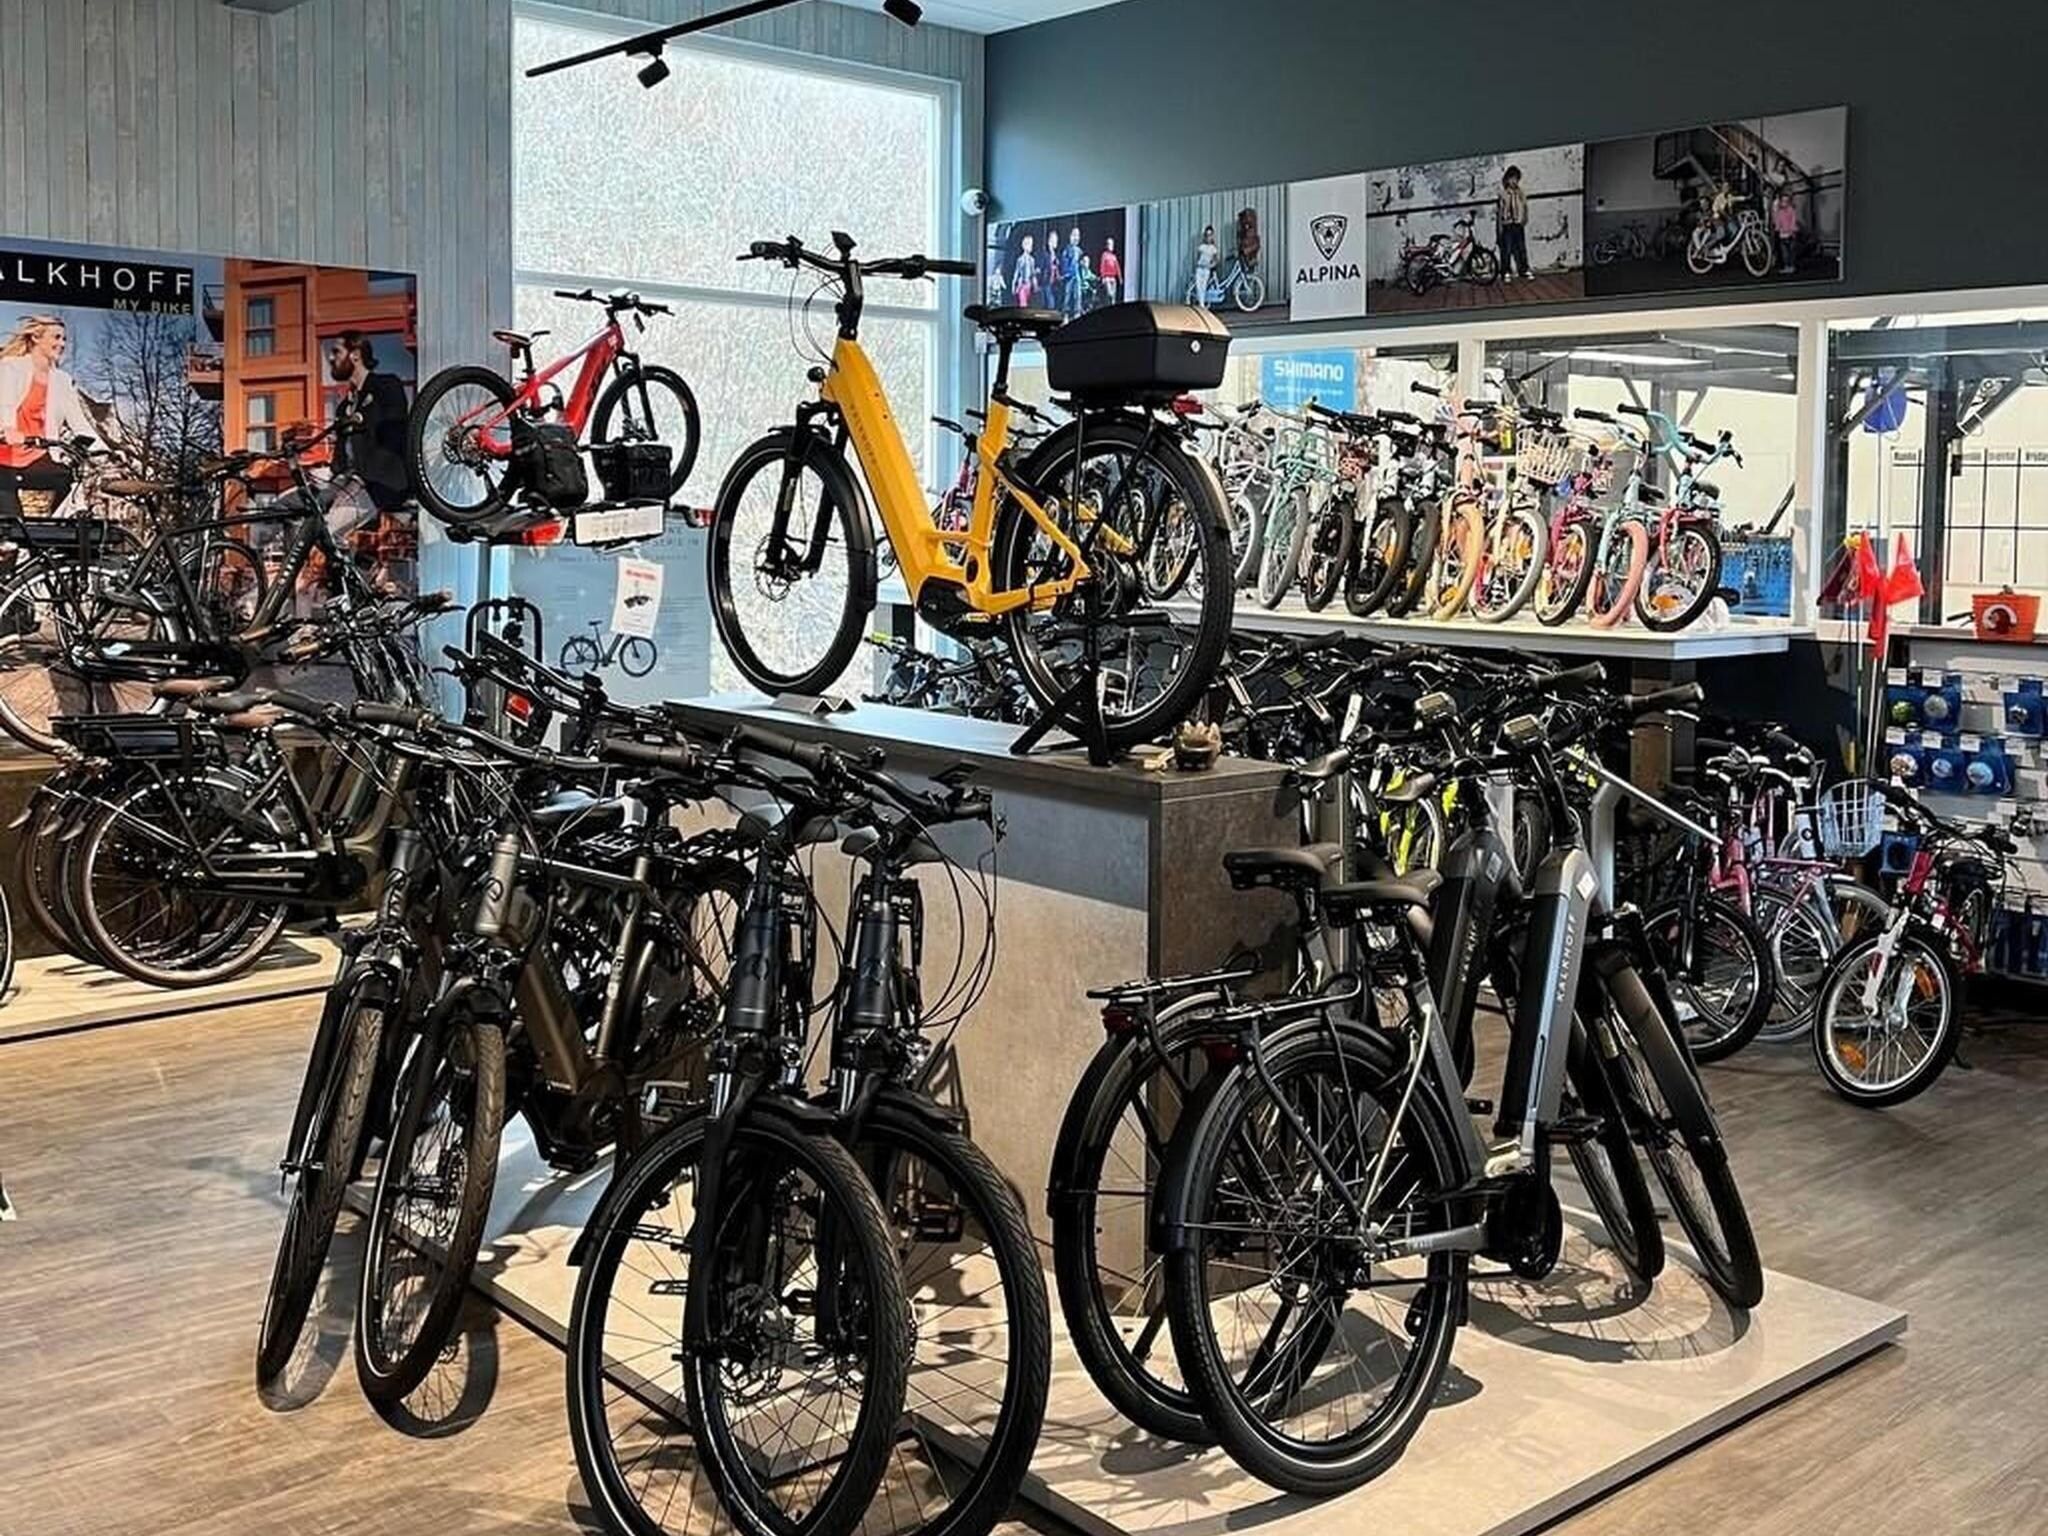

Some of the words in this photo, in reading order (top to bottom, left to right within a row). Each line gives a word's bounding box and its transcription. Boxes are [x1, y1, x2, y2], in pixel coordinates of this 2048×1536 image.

[0, 260, 191, 295] LKHOFF
[1296, 263, 1361, 284] ALPINA
[113, 298, 140, 311] MY
[151, 300, 191, 316] BIKE
[1273, 359, 1344, 382] SHIMANO
[1556, 912, 1577, 1002] KALKHOFF
